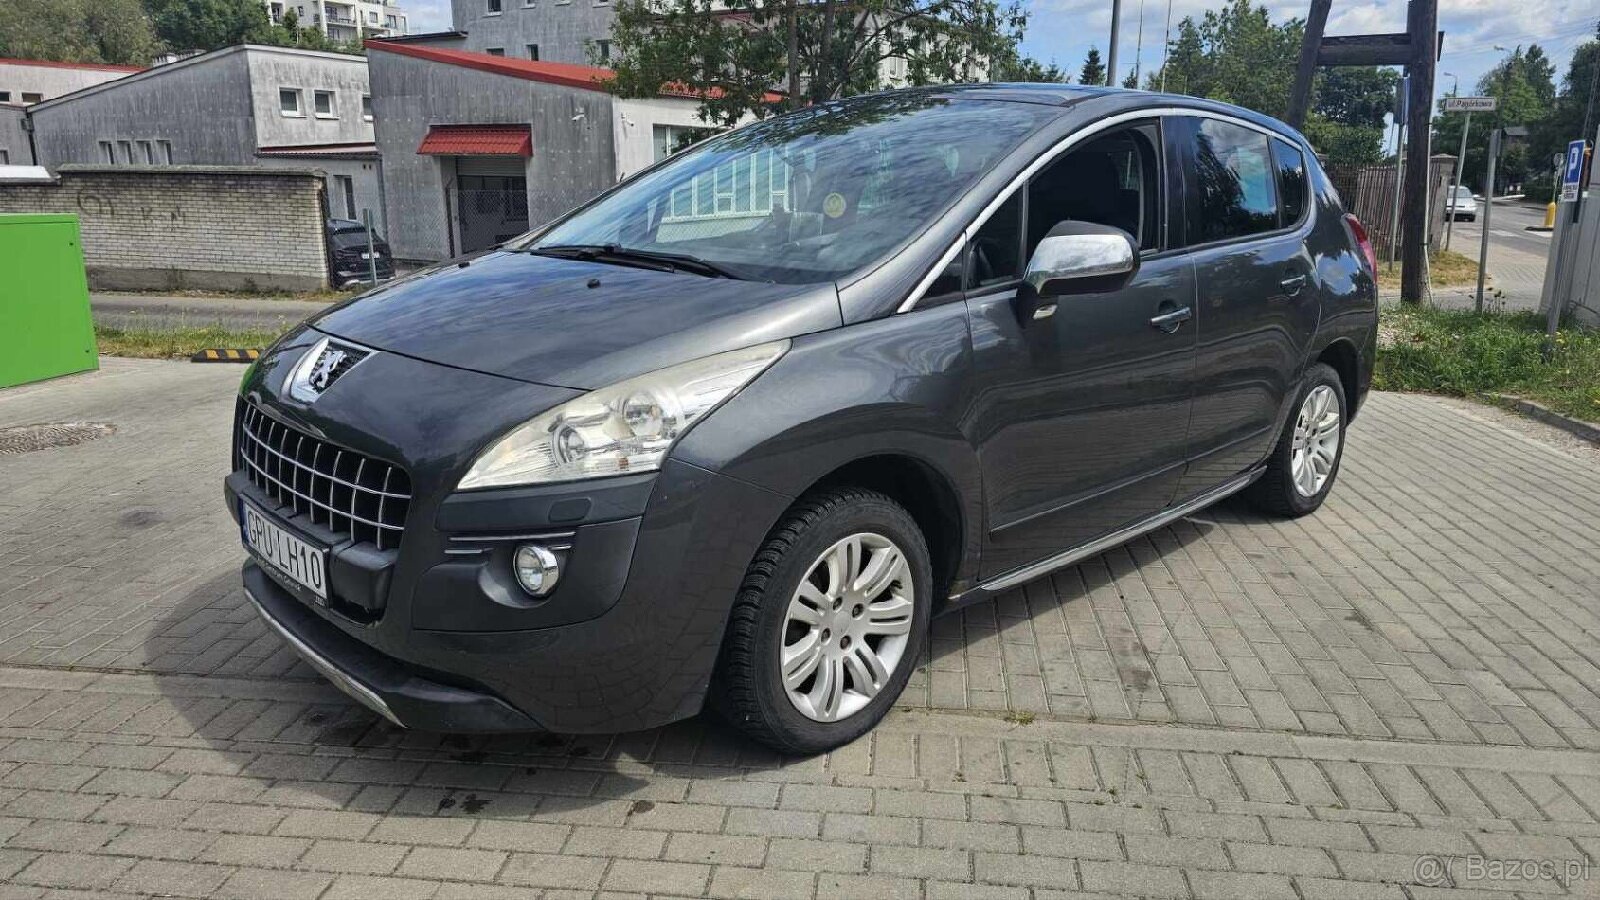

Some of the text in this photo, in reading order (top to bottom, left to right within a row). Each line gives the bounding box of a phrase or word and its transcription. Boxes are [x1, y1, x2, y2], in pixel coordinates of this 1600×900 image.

[1568, 147, 1579, 178] P
[248, 511, 273, 556] GPU
[277, 530, 321, 588] LH10
